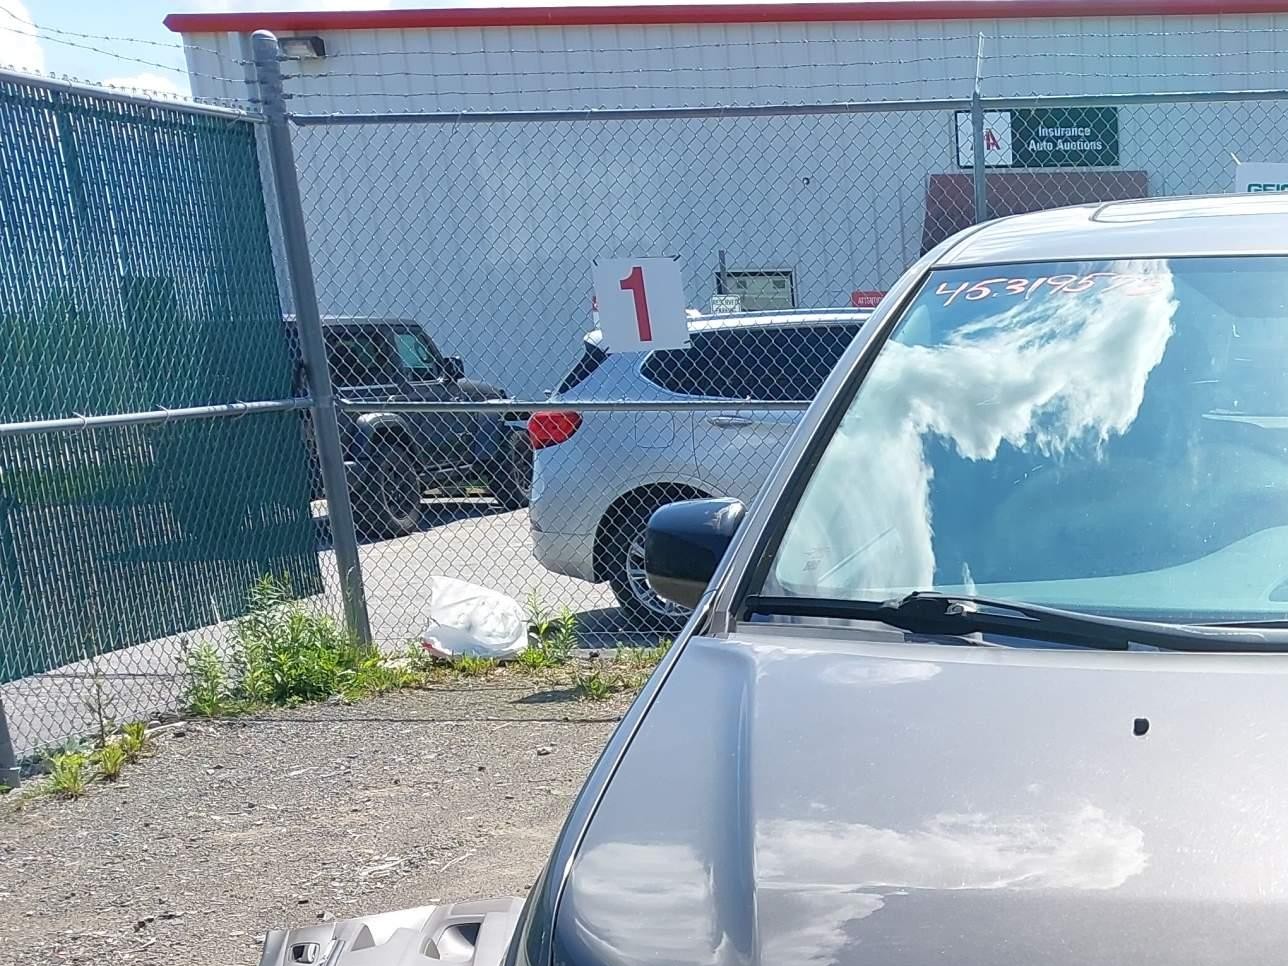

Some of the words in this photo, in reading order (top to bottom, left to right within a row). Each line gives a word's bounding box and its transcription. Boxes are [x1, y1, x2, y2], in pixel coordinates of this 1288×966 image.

[1038, 125, 1091, 137] Insurance
[1028, 140, 1054, 151] Auto
[1055, 139, 1103, 151] Auctions
[619, 266, 653, 342] 1
